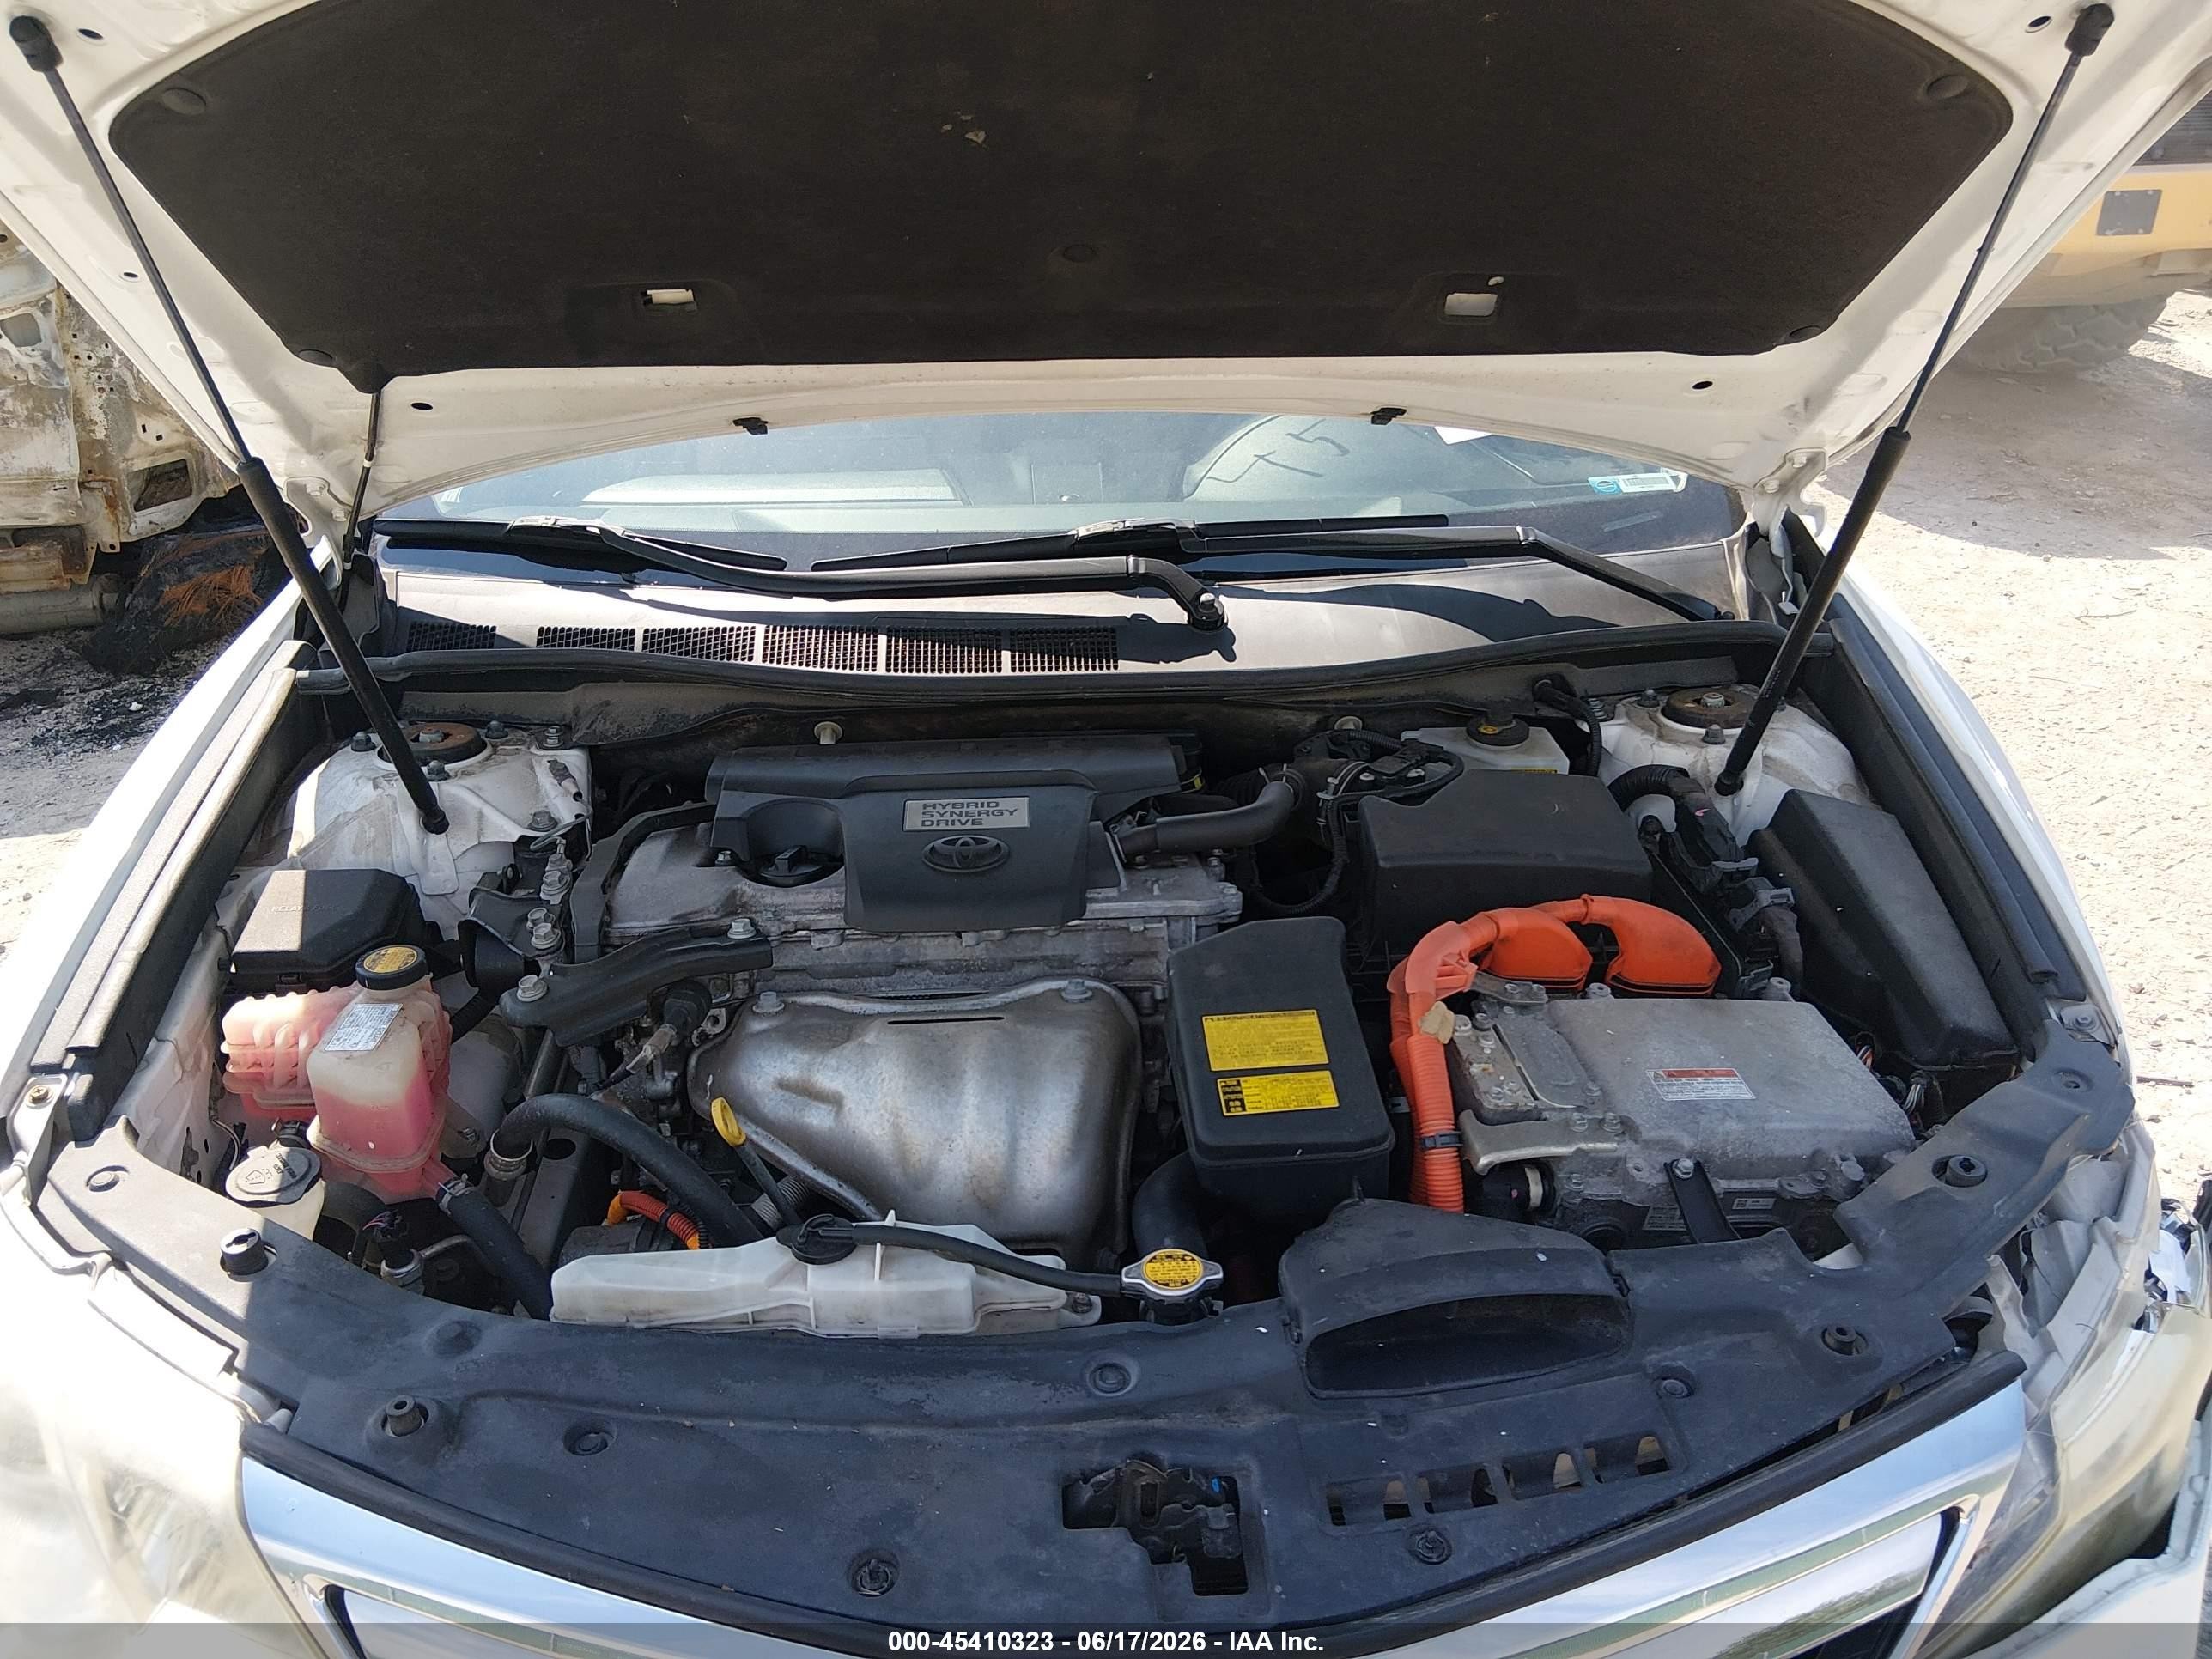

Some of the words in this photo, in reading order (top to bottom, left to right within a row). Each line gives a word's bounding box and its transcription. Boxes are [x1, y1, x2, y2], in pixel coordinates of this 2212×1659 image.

[922, 801, 1000, 810] HYBRID
[921, 808, 1018, 818] SYNERGY
[921, 818, 983, 827] DRIVE
